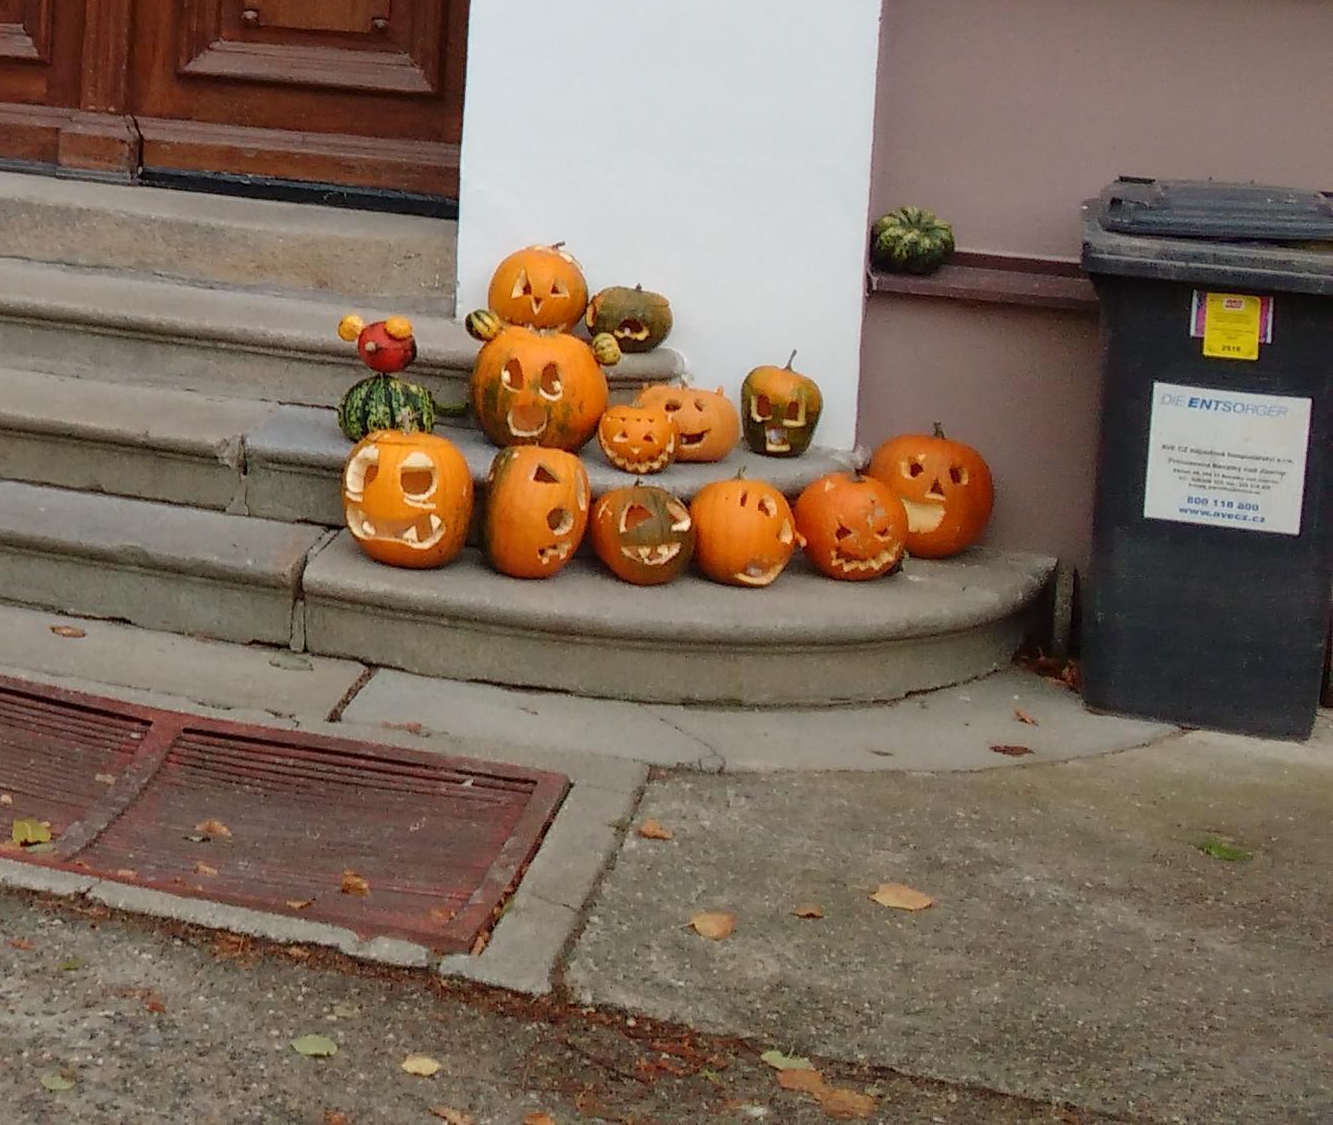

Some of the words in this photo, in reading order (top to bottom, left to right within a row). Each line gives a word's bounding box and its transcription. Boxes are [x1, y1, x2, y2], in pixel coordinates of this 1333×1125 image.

[1160, 394, 1185, 407] DIE
[1188, 396, 1289, 417] ENTSORGER
[1179, 507, 1266, 523] www.avecz.cz
